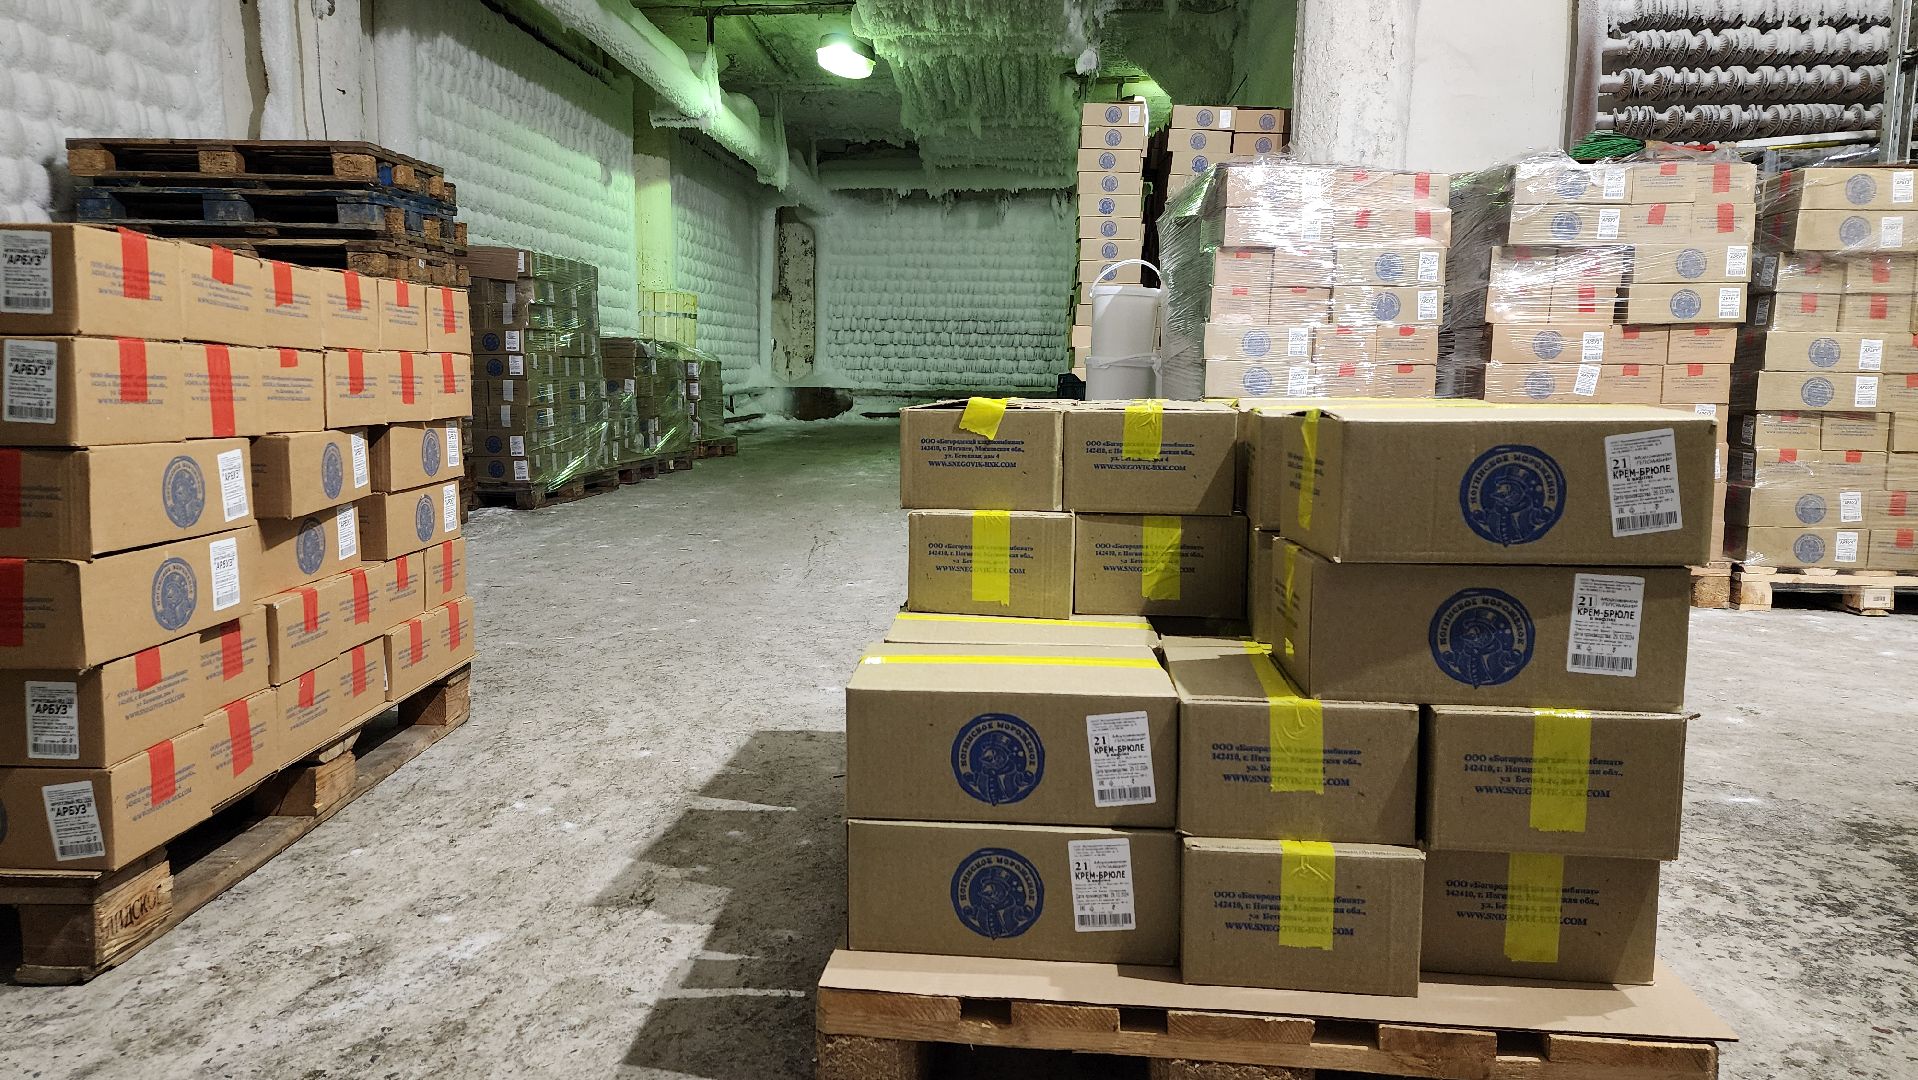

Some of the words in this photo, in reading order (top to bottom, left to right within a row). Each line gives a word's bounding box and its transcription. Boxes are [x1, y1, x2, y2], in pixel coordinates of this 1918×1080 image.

[1612, 458, 1627, 470] 21
[1612, 464, 1671, 480] КРЕМ-БРЮЛЕ
[1578, 596, 1593, 606] 21
[1578, 608, 1635, 620] КРЕМ-БРЮЛЕ
[32, 704, 72, 715] "АРБУЗ"
[1094, 736, 1106, 746] 21
[1094, 744, 1145, 754] КРЕМ-БРЮЛЕ
[1464, 754, 1486, 762] ООО
[50, 804, 92, 817] "АРБУЗ"
[1074, 862, 1088, 871] 21
[1075, 870, 1126, 880] КРЕМ-БРЮЛЕ
